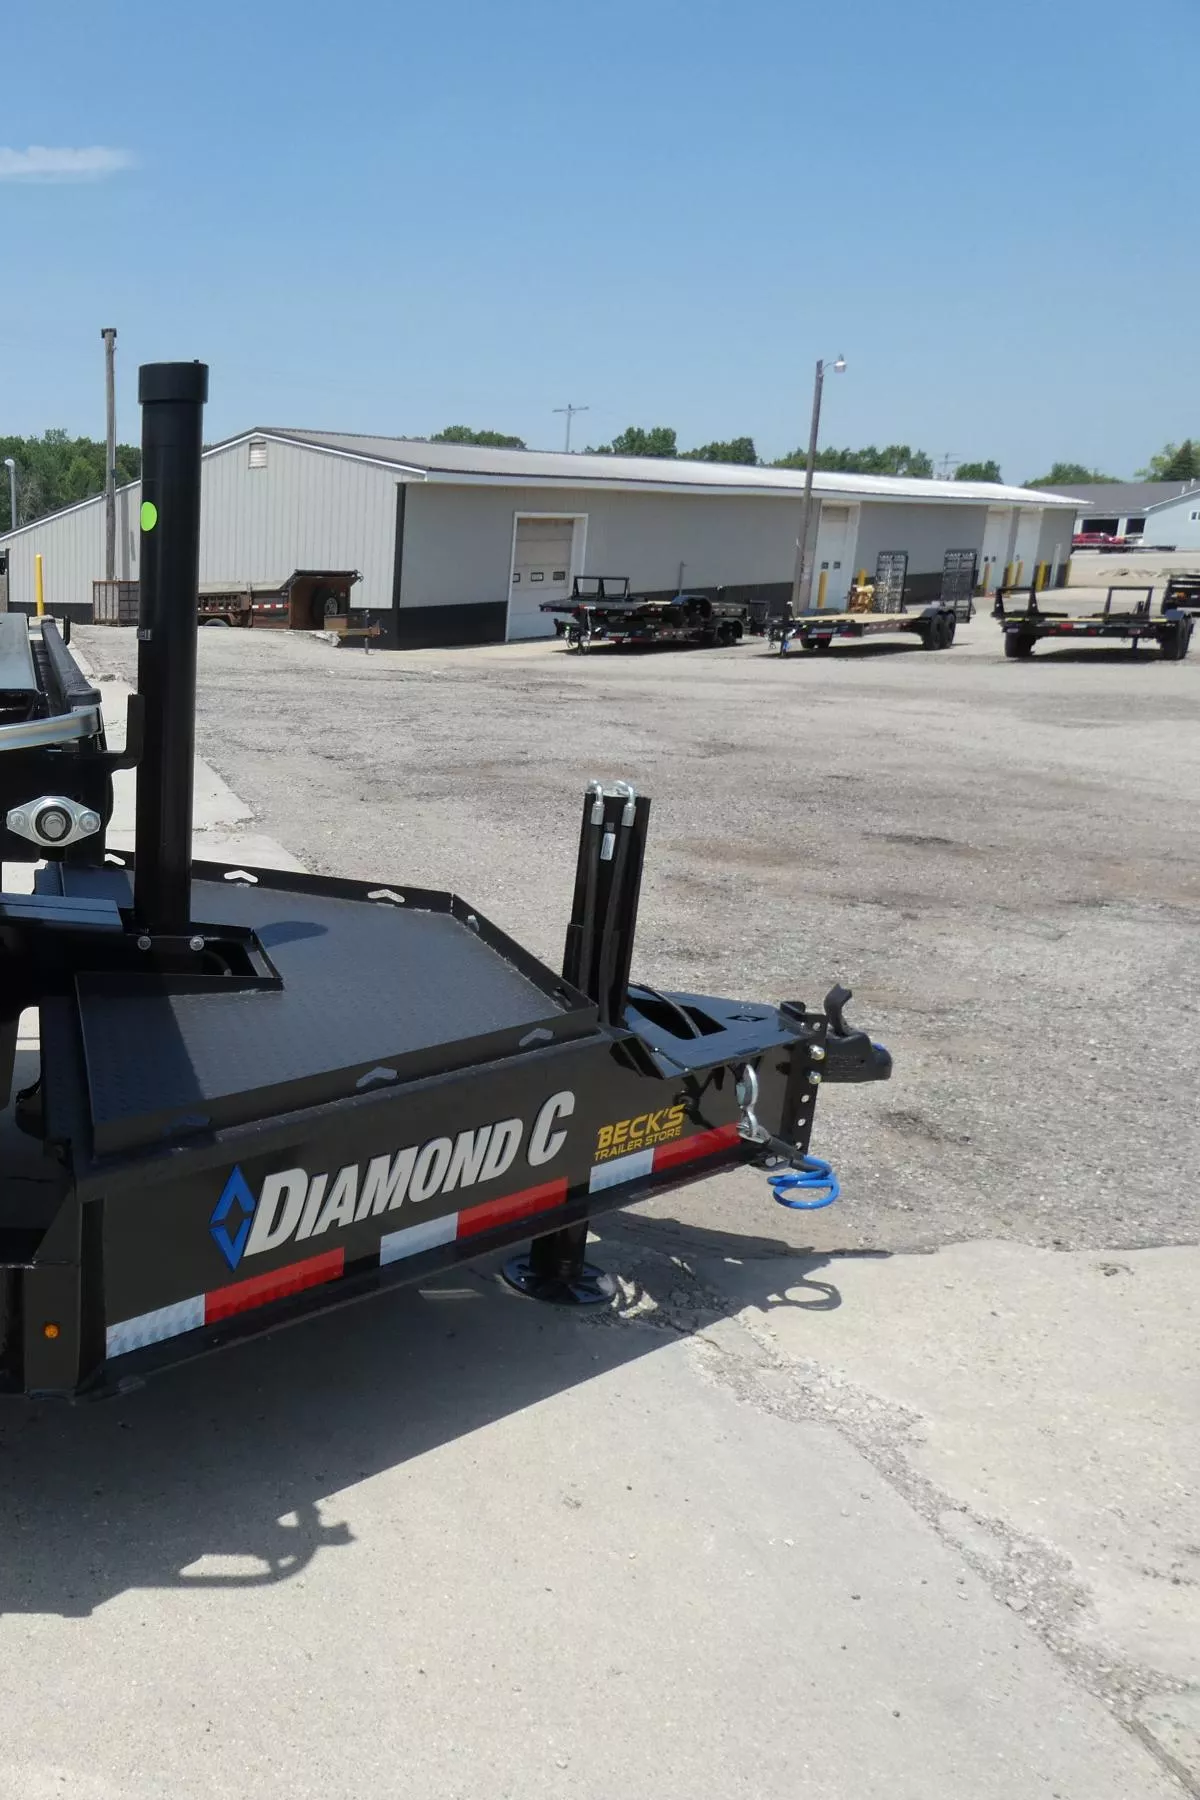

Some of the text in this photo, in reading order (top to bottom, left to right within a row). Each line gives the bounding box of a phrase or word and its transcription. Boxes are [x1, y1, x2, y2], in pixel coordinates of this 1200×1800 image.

[594, 1126, 682, 1161] TRAILER STORE
[597, 1104, 686, 1149] BECK'S
[244, 1090, 576, 1256] DIAMOND C
